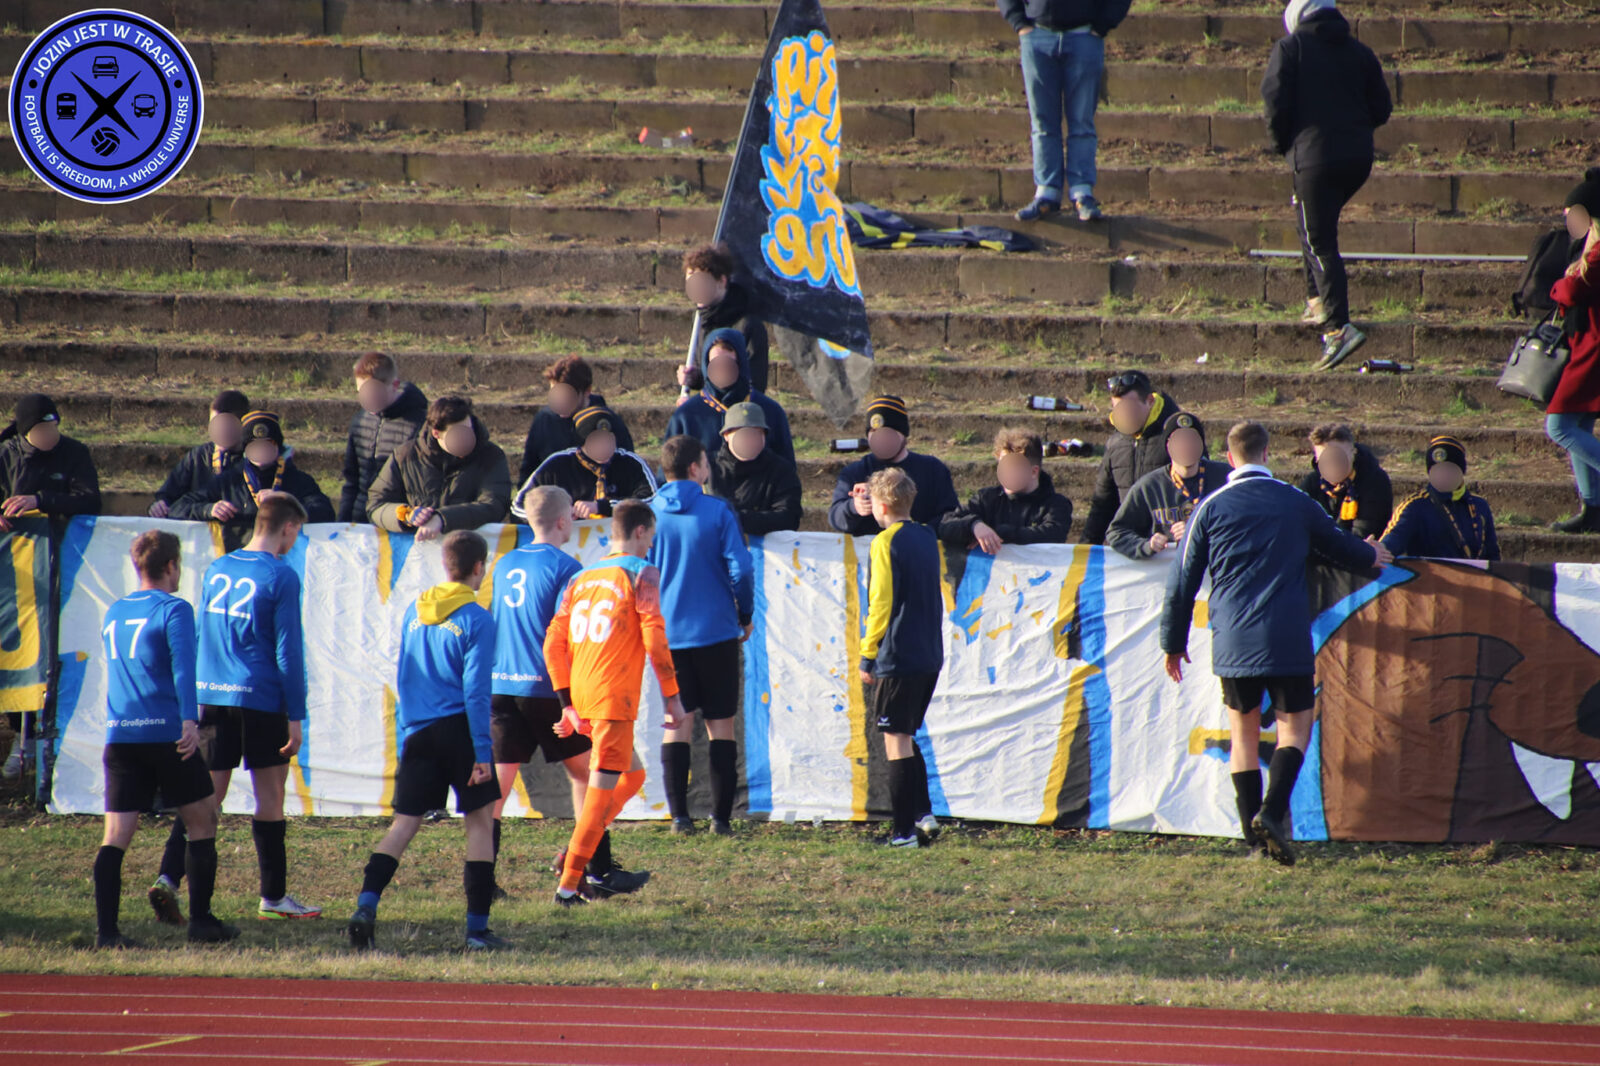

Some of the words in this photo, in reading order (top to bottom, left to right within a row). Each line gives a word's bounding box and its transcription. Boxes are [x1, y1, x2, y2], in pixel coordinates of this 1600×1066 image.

[205, 573, 257, 619] 22
[503, 568, 527, 608] 3
[103, 618, 148, 660] 17
[569, 599, 614, 643] 66
